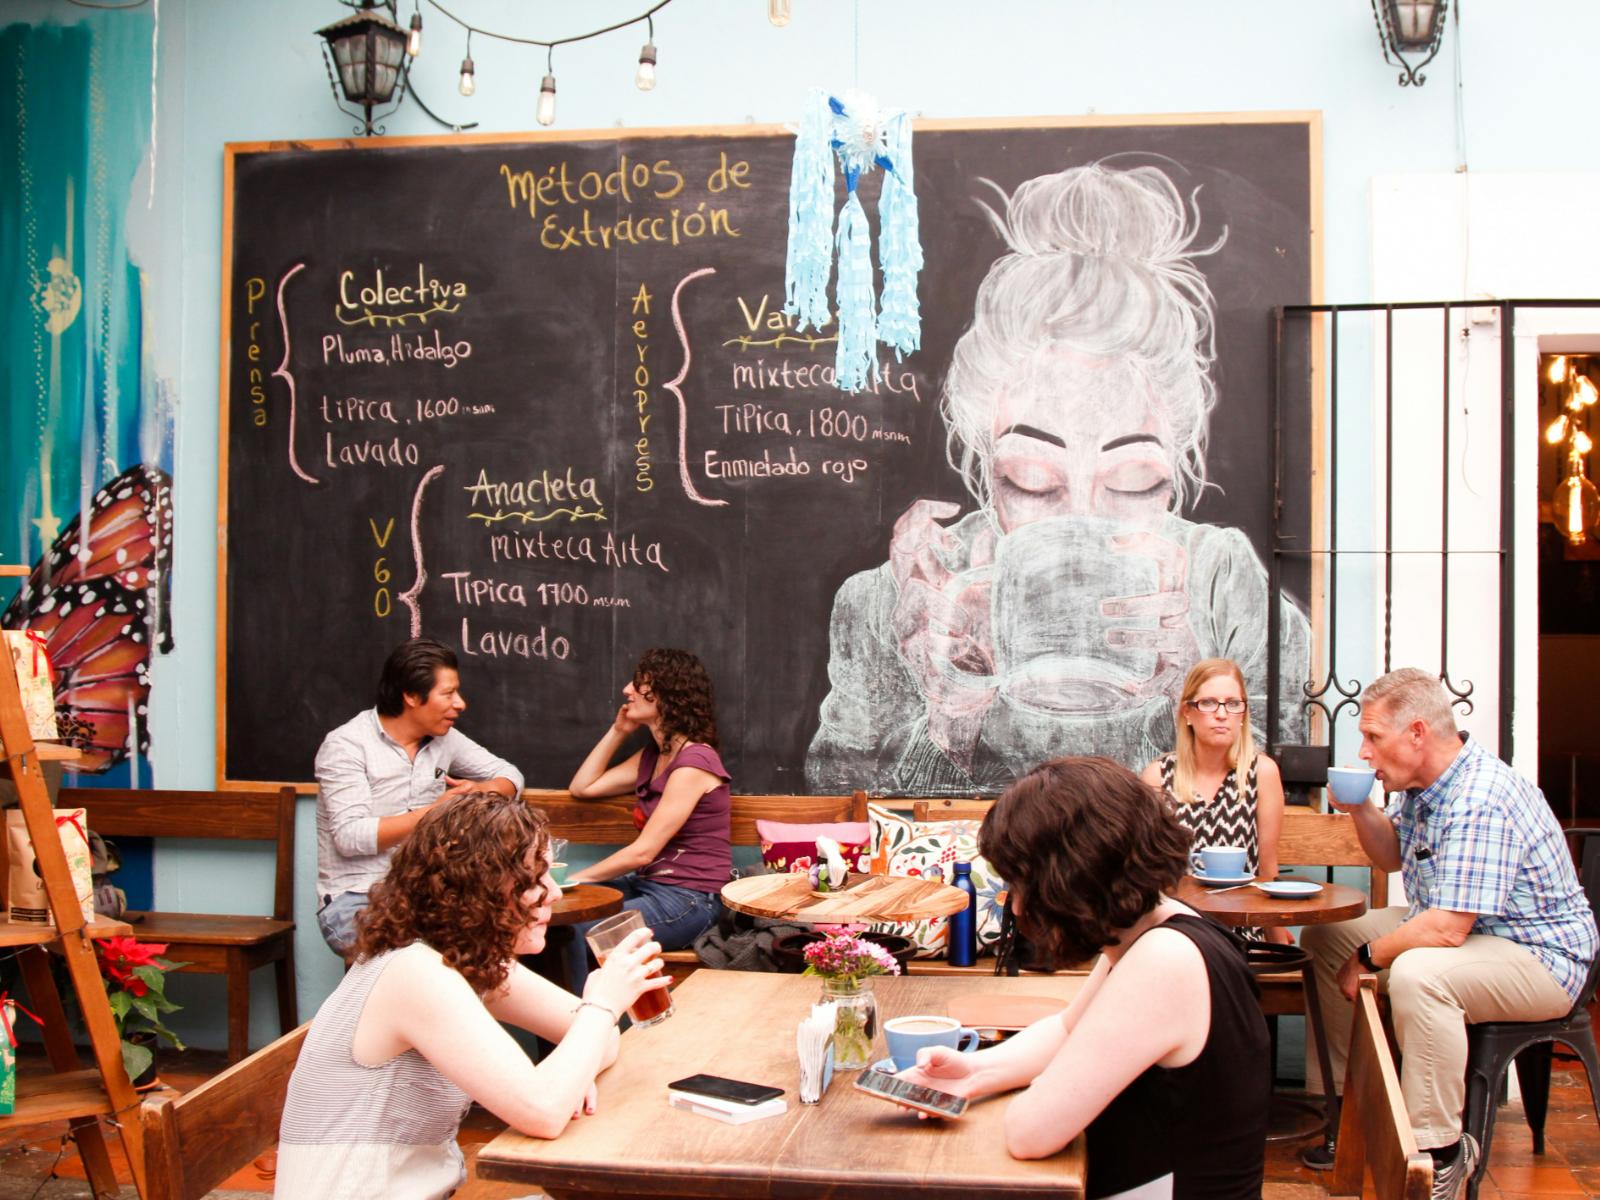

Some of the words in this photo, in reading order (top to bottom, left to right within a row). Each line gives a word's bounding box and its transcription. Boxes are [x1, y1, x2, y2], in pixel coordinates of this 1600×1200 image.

[500, 154, 685, 218] Métodos
[708, 151, 752, 193] de
[540, 202, 741, 250] Extracción
[340, 263, 467, 309] Colectiva
[245, 277, 267, 427] Prensa
[416, 397, 459, 422] 1600
[809, 407, 868, 441] 1800
[326, 432, 419, 468] Lavado
[821, 458, 868, 483] rojo
[463, 467, 602, 507] Anacleta
[369, 517, 394, 618] V60
[601, 531, 669, 572] Alta
[536, 582, 589, 606] 1700
[462, 617, 570, 660] Lavado
